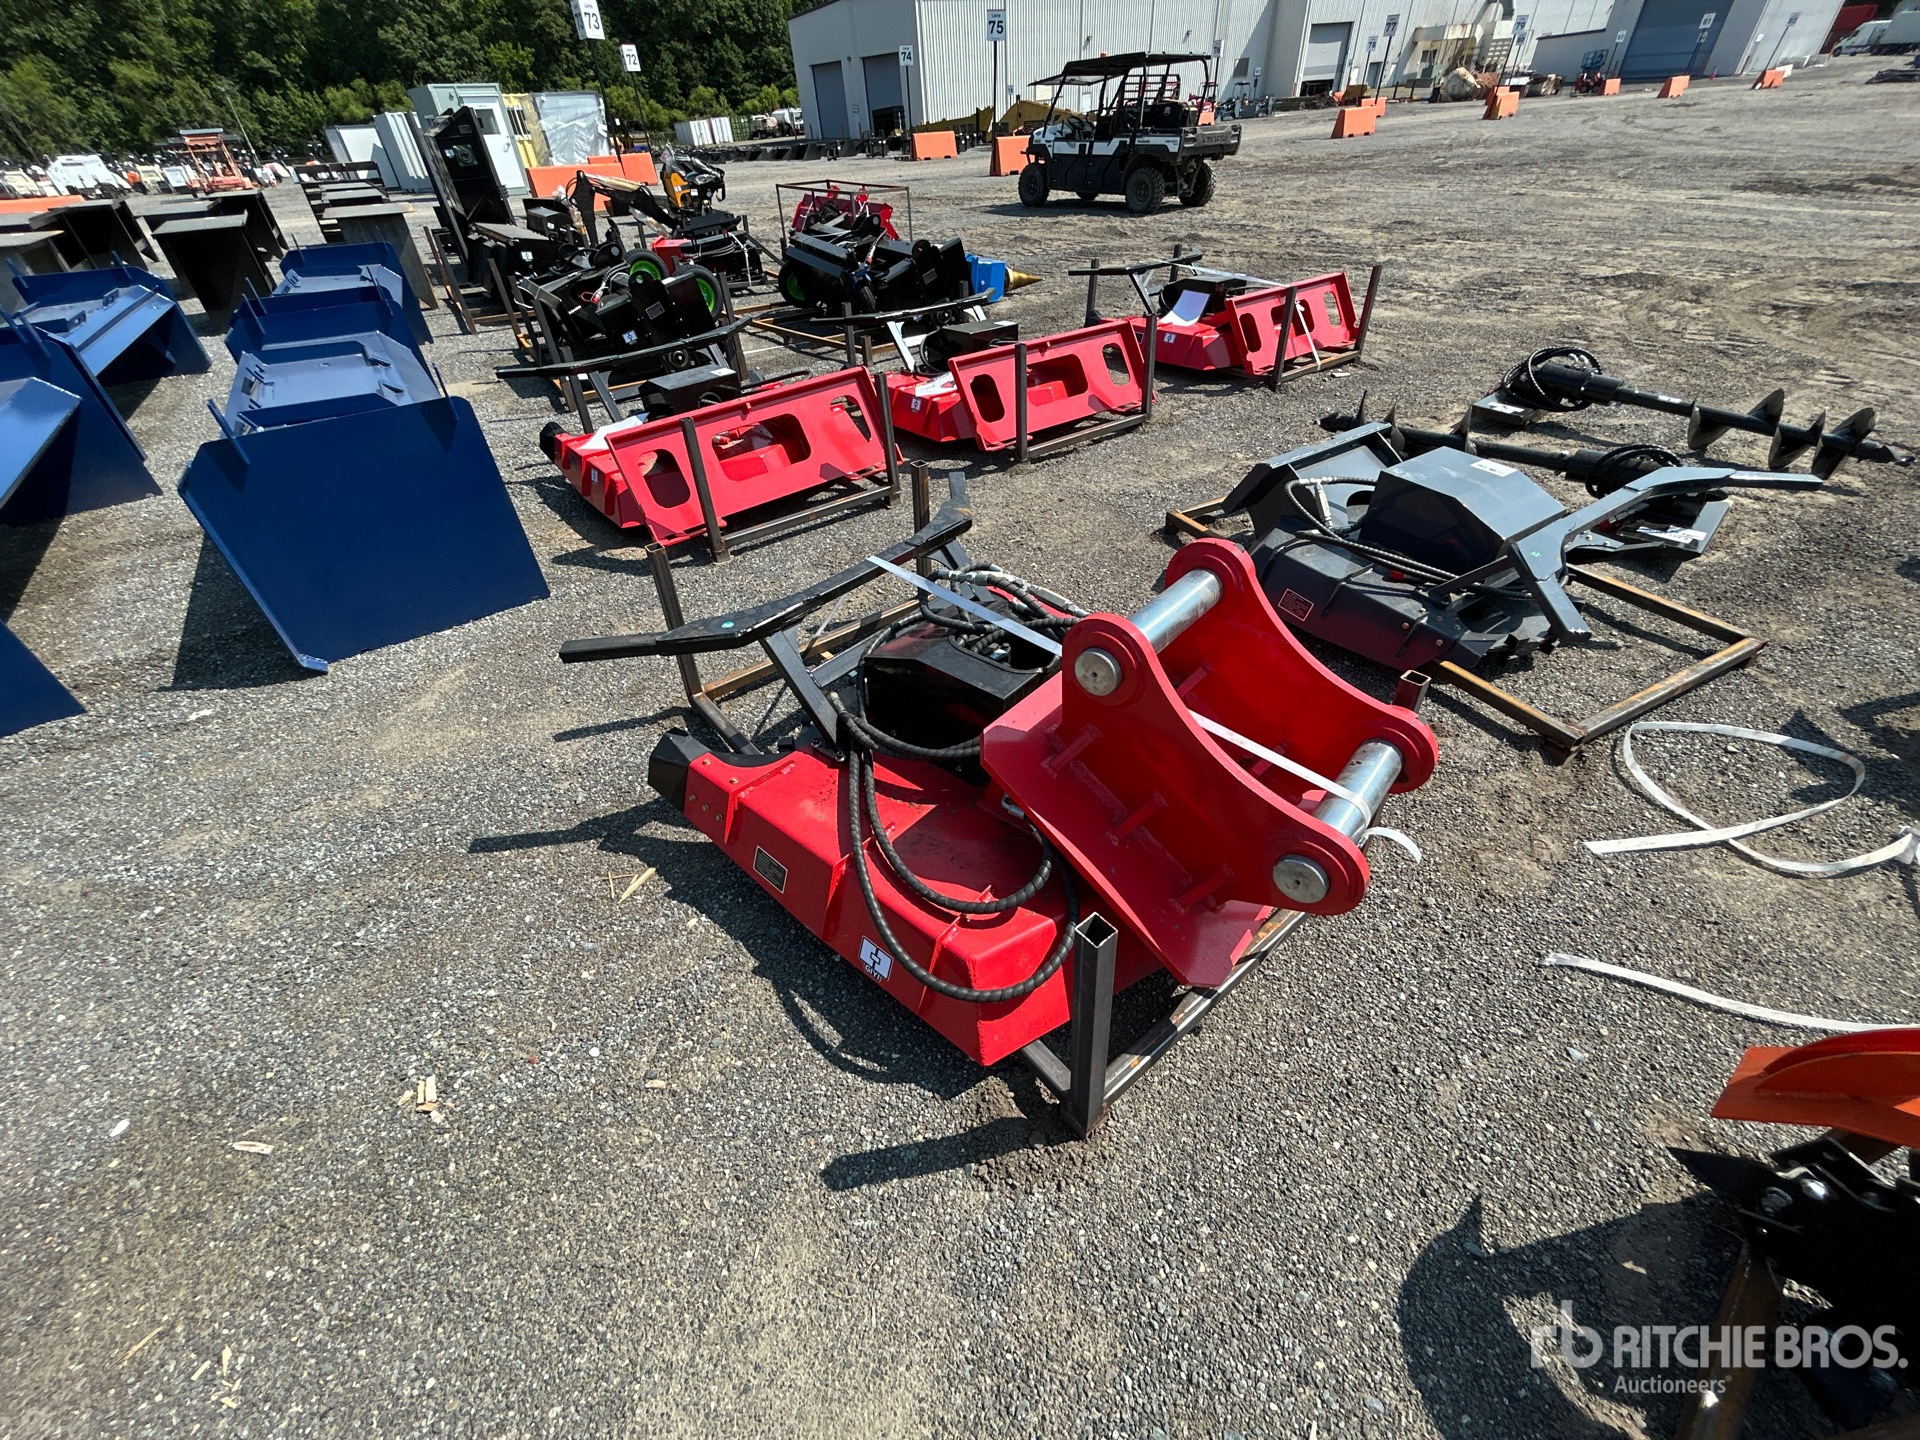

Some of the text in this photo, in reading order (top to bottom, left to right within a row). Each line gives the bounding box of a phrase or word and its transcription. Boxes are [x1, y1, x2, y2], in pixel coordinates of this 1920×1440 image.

[584, 12, 600, 30] 73
[1386, 21, 1397, 33] 77
[1515, 21, 1526, 31] 79
[988, 20, 1004, 35] 75
[625, 54, 638, 66] 72
[900, 51, 912, 62] 74
